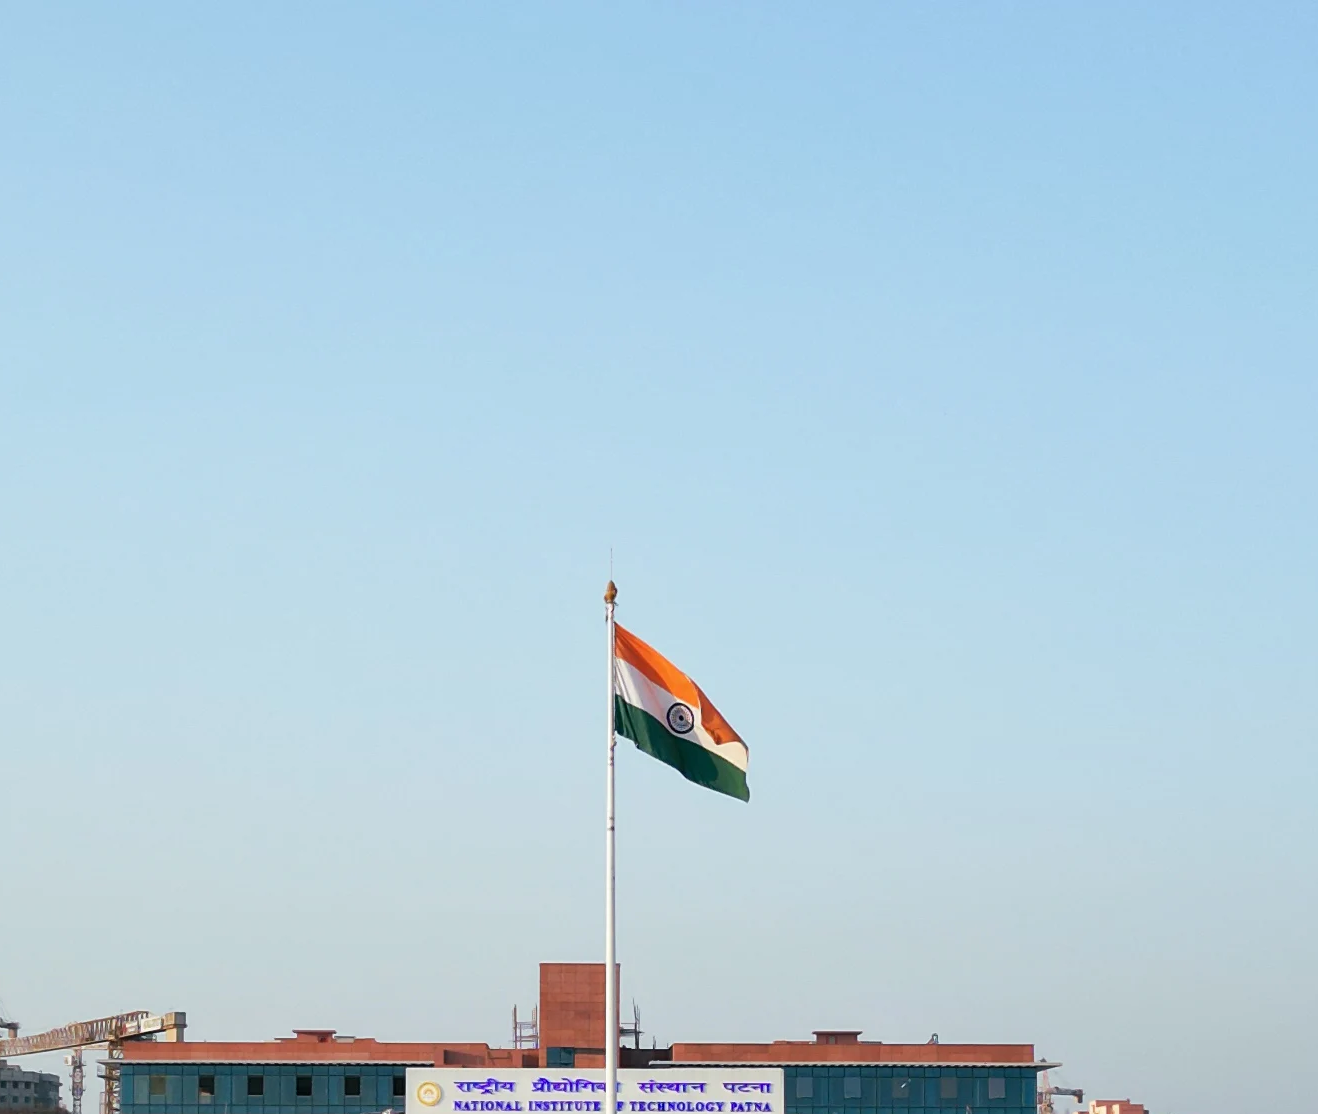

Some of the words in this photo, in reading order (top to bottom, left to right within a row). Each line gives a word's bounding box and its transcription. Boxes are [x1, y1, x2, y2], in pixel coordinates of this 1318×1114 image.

[454, 1078, 516, 1095] राष्ट्रीय
[637, 1080, 707, 1094] संस्थान
[723, 1082, 773, 1093] पटना
[453, 1101, 522, 1112] NATIONAL
[528, 1101, 601, 1112] INSTITUTE
[629, 1101, 725, 1113] TECHNOLOGY
[730, 1101, 773, 1113] PATNA
